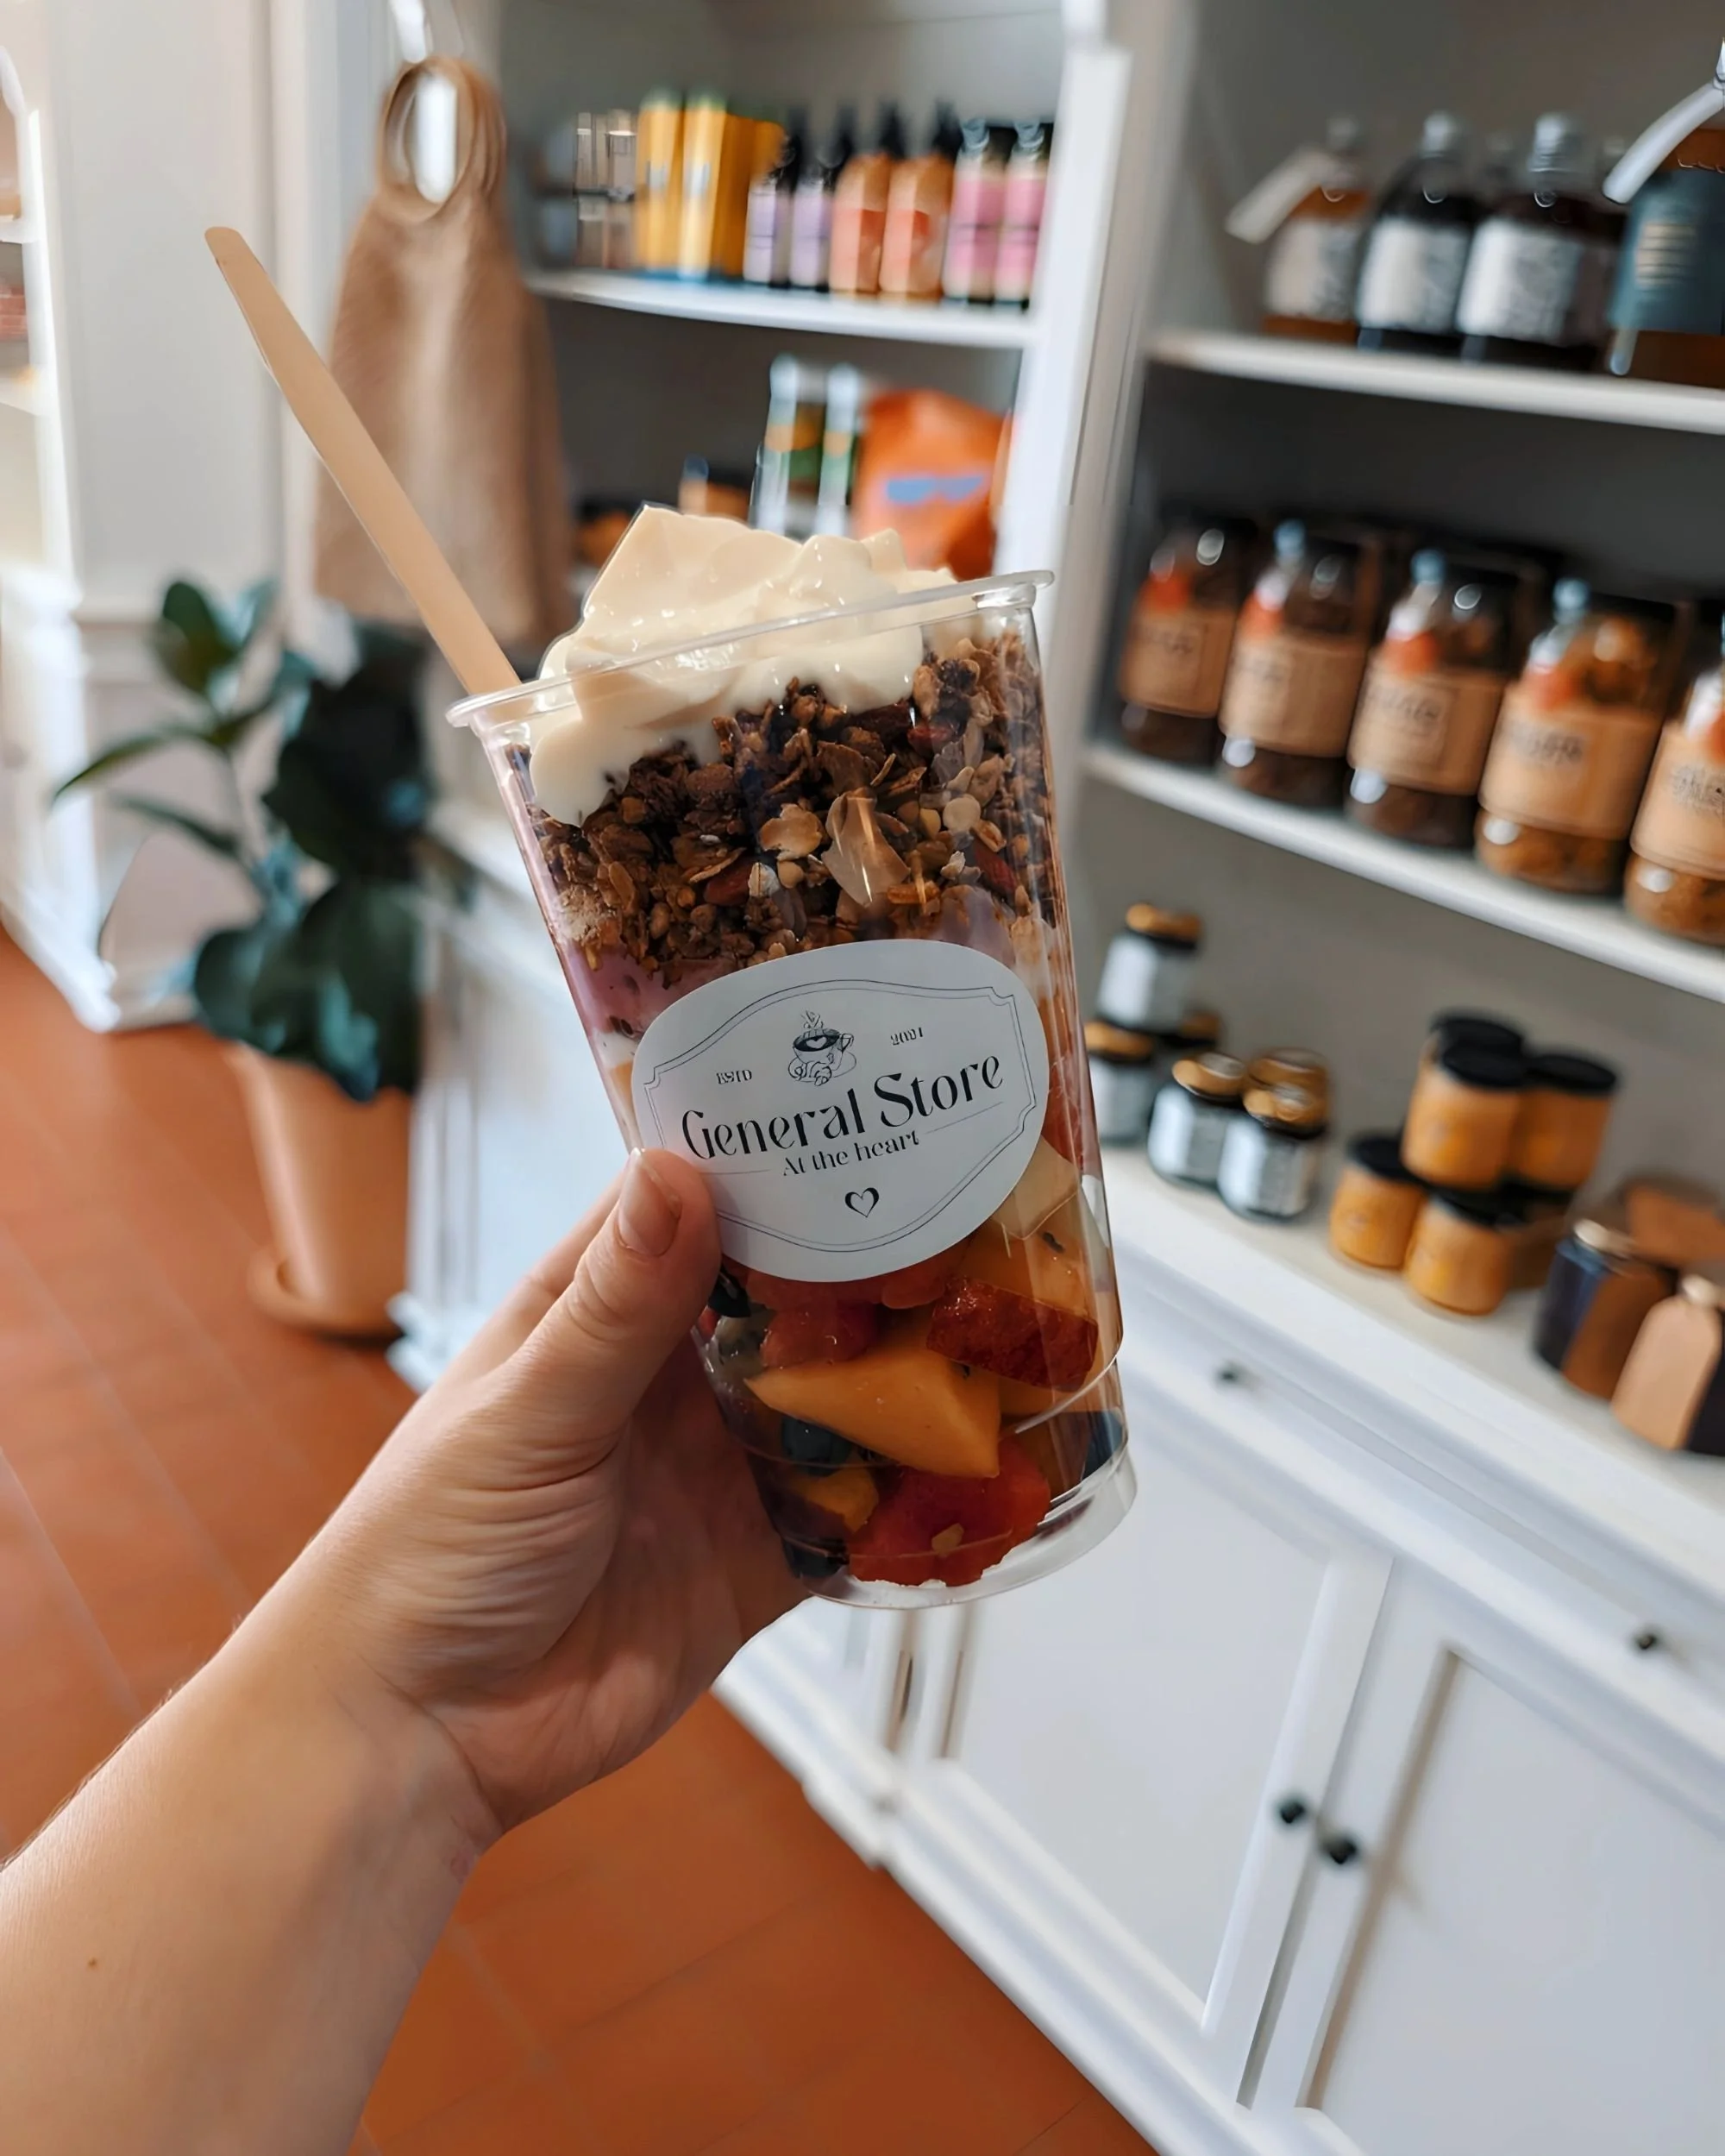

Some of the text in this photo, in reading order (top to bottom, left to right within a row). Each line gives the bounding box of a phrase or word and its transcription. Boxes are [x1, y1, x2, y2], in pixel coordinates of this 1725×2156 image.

[681, 1055, 1003, 1160] General Store
[783, 1130, 920, 1177] At the heart
